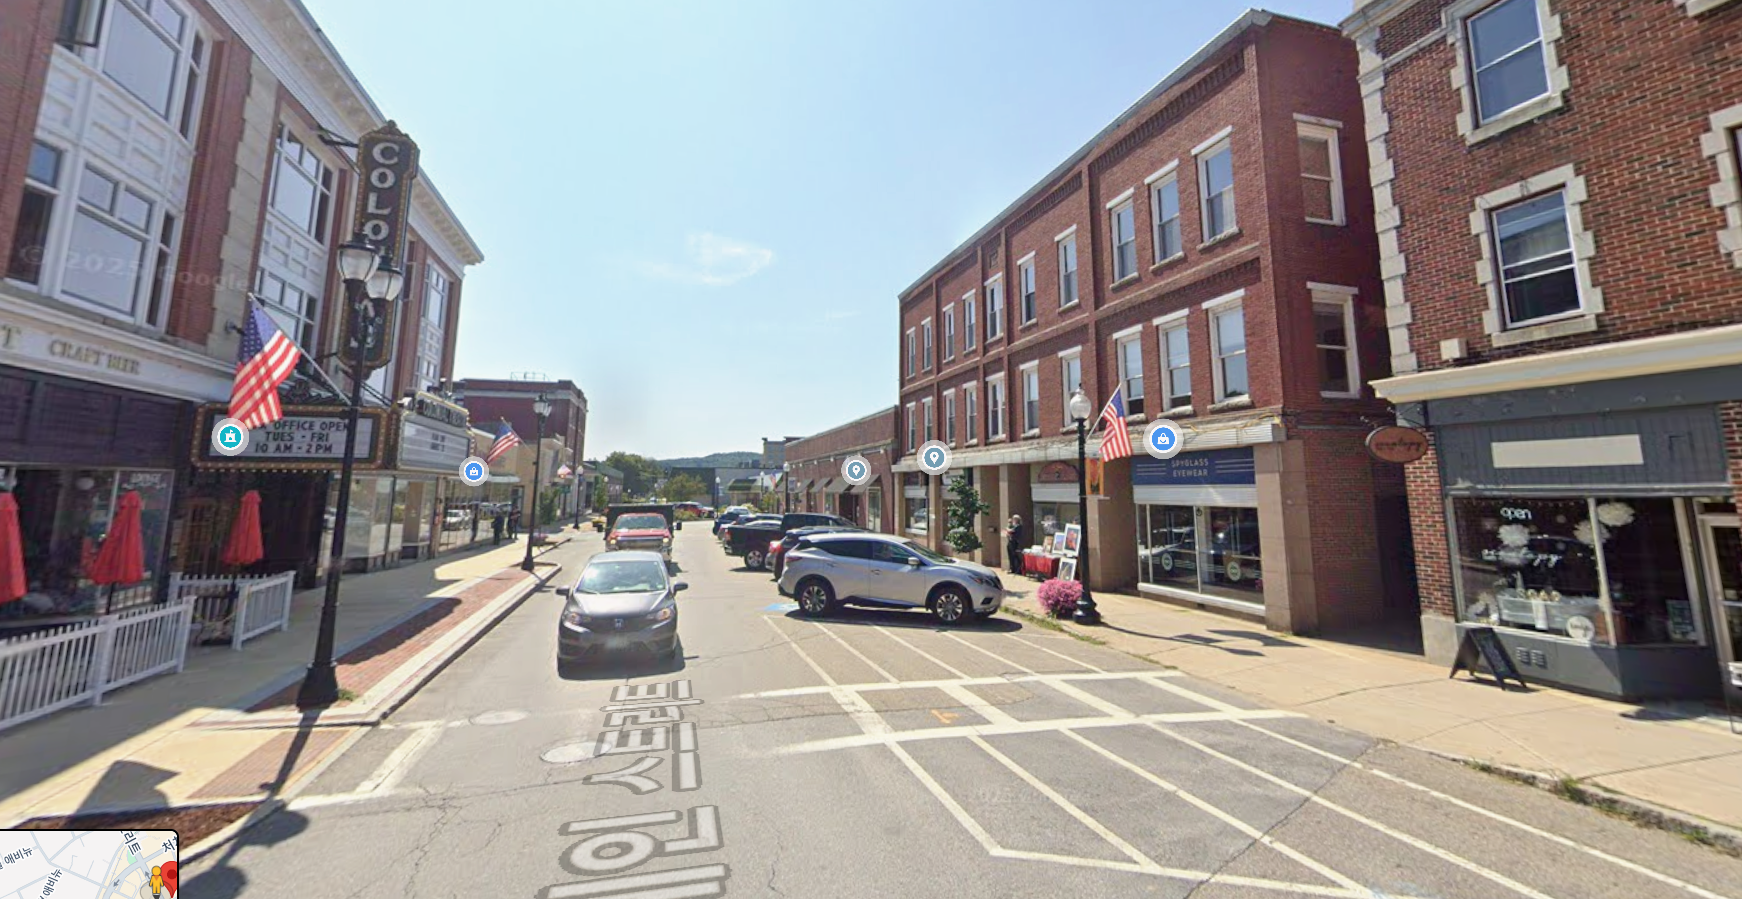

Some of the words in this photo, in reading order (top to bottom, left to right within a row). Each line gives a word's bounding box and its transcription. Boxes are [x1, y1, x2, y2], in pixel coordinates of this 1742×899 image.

[50, 340, 101, 365] CRAFT
[106, 353, 140, 375] BEER
[273, 420, 315, 431] OFFICE
[265, 431, 294, 442] TUES
[310, 432, 329, 442] FRI
[254, 443, 268, 453] 10
[273, 443, 293, 453] AM
[1171, 458, 1209, 468] SPYGLASS
[1172, 468, 1209, 478] EYEWEAR
[1500, 507, 1532, 520] open
